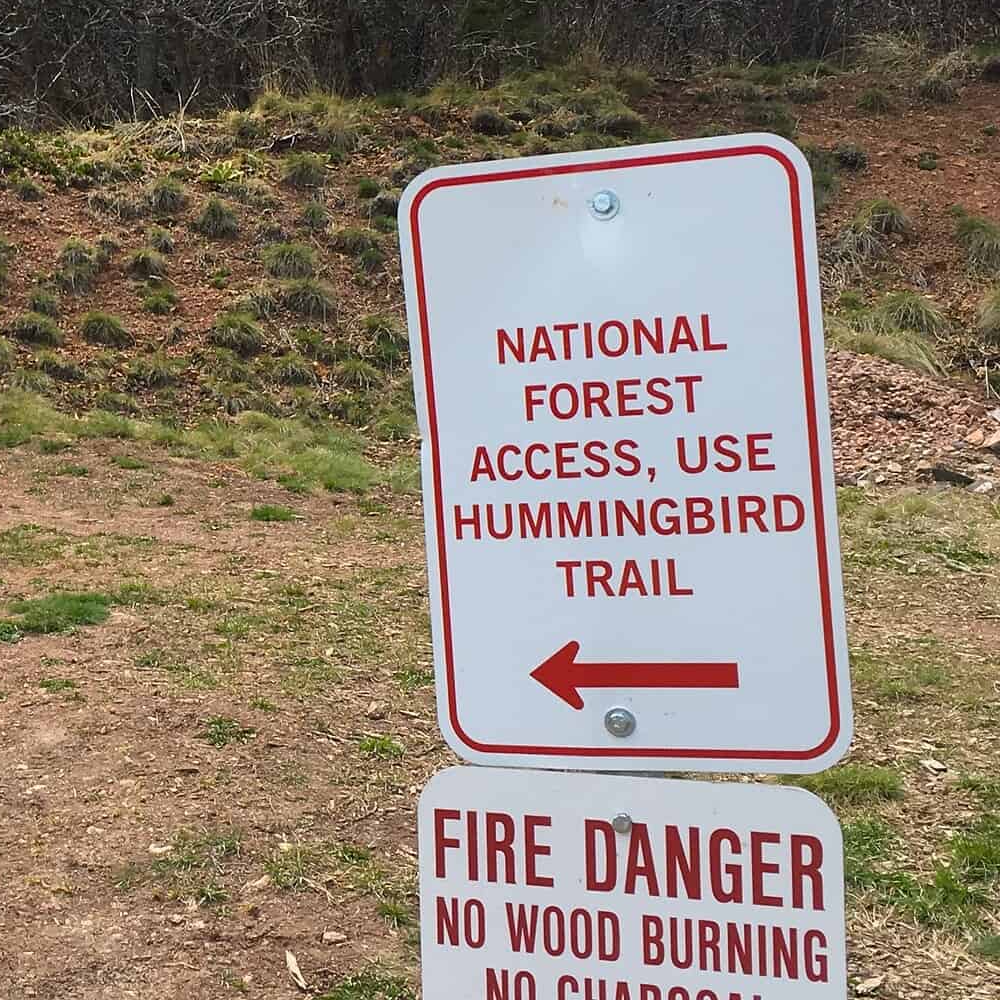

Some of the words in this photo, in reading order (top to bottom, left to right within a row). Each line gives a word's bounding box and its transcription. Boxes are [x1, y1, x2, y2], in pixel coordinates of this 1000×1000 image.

[496, 314, 728, 365] NATIONAL
[524, 376, 703, 422] FOREST
[470, 439, 656, 482] ACCESS,
[676, 433, 776, 475] USE
[454, 494, 806, 541] HUMMINGBIRD
[556, 559, 693, 598] TRAIL
[434, 808, 554, 888] FIRE
[584, 818, 826, 911] DANGER
[436, 896, 486, 949] NO
[506, 903, 621, 962] WOOD
[642, 914, 829, 983] BURNING
[486, 967, 537, 1000] NO
